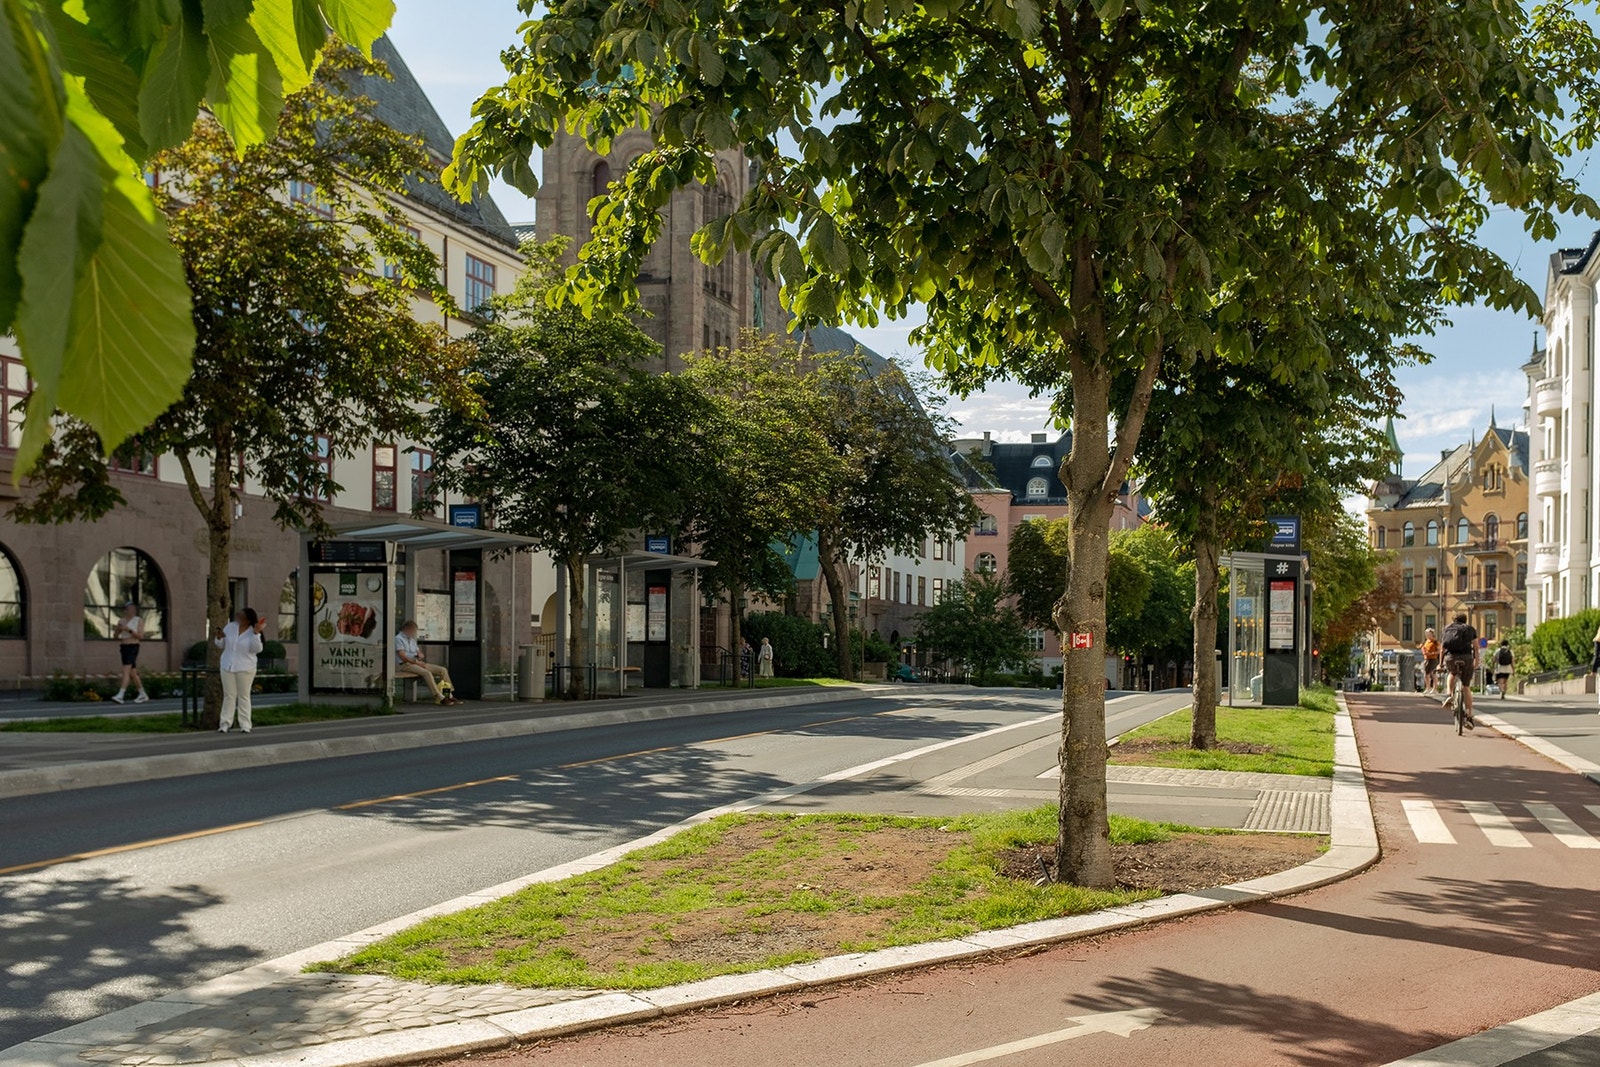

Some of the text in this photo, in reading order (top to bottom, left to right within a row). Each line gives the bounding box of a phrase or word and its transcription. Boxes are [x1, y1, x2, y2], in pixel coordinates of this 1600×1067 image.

[330, 648, 365, 657] VANN I
[322, 659, 374, 668] MUNNEN?
